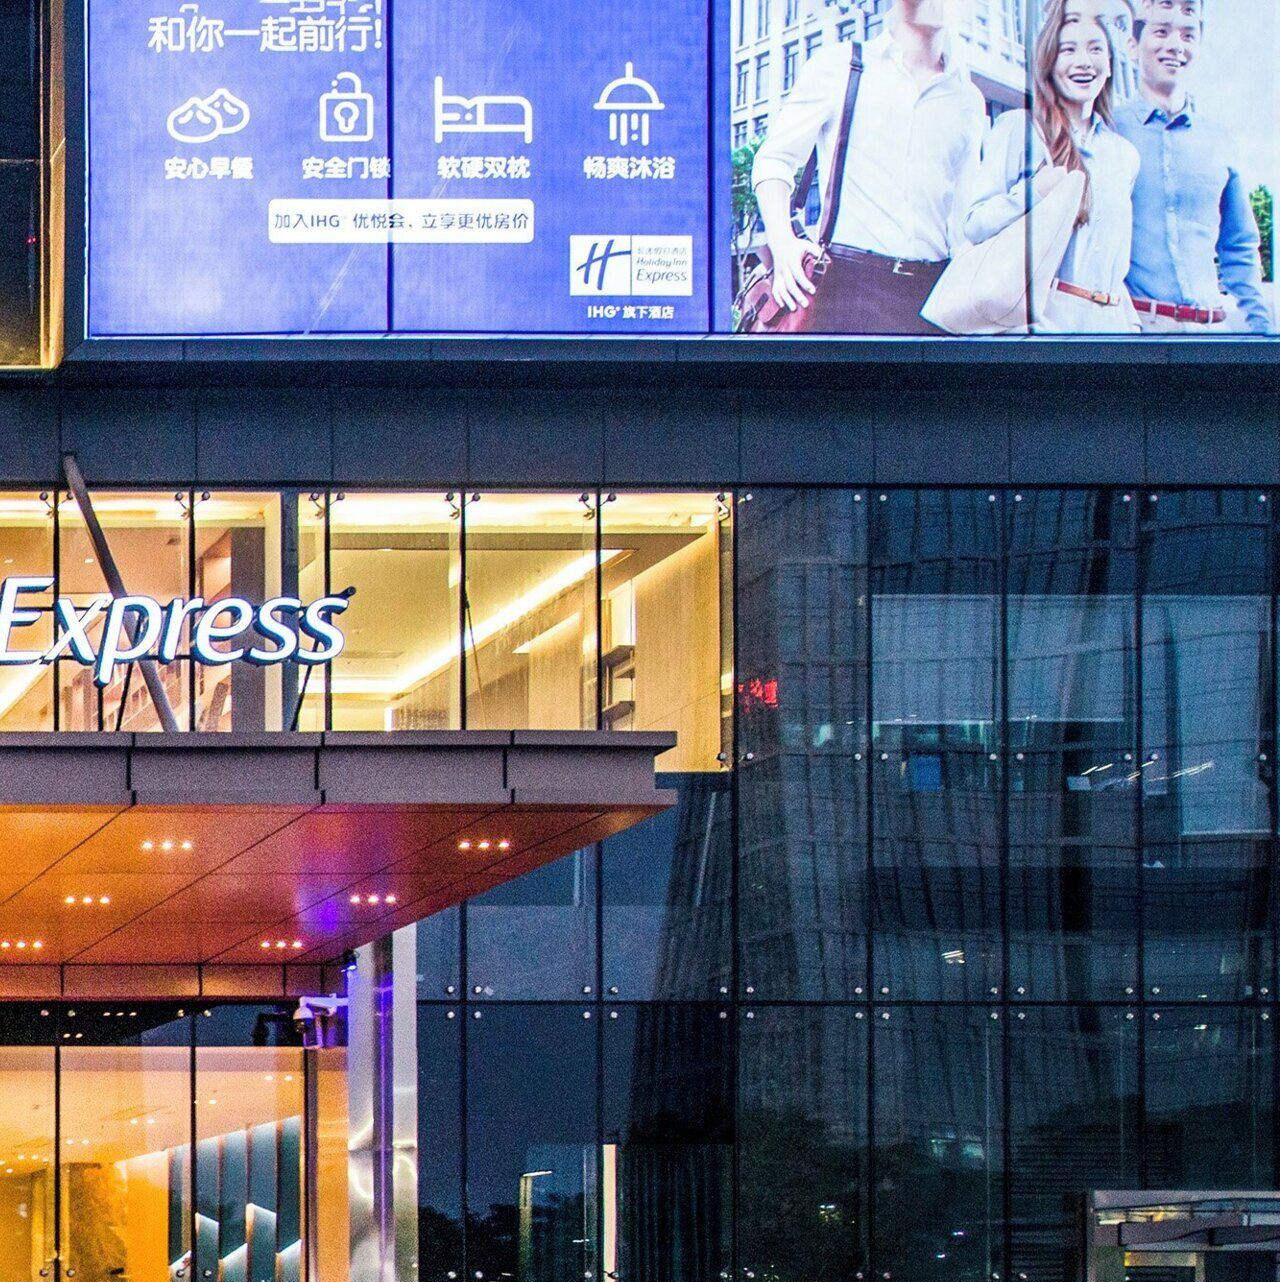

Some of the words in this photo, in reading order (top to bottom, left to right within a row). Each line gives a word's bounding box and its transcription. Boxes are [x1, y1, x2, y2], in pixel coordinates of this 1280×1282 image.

[147, 15, 383, 53] 和你一起前行!
[164, 156, 254, 180] 安心早餐
[301, 156, 391, 180] 安全门锁
[436, 156, 531, 179] 软硬双枕
[582, 156, 675, 180] 畅爽沐浴
[636, 268, 687, 284] Express
